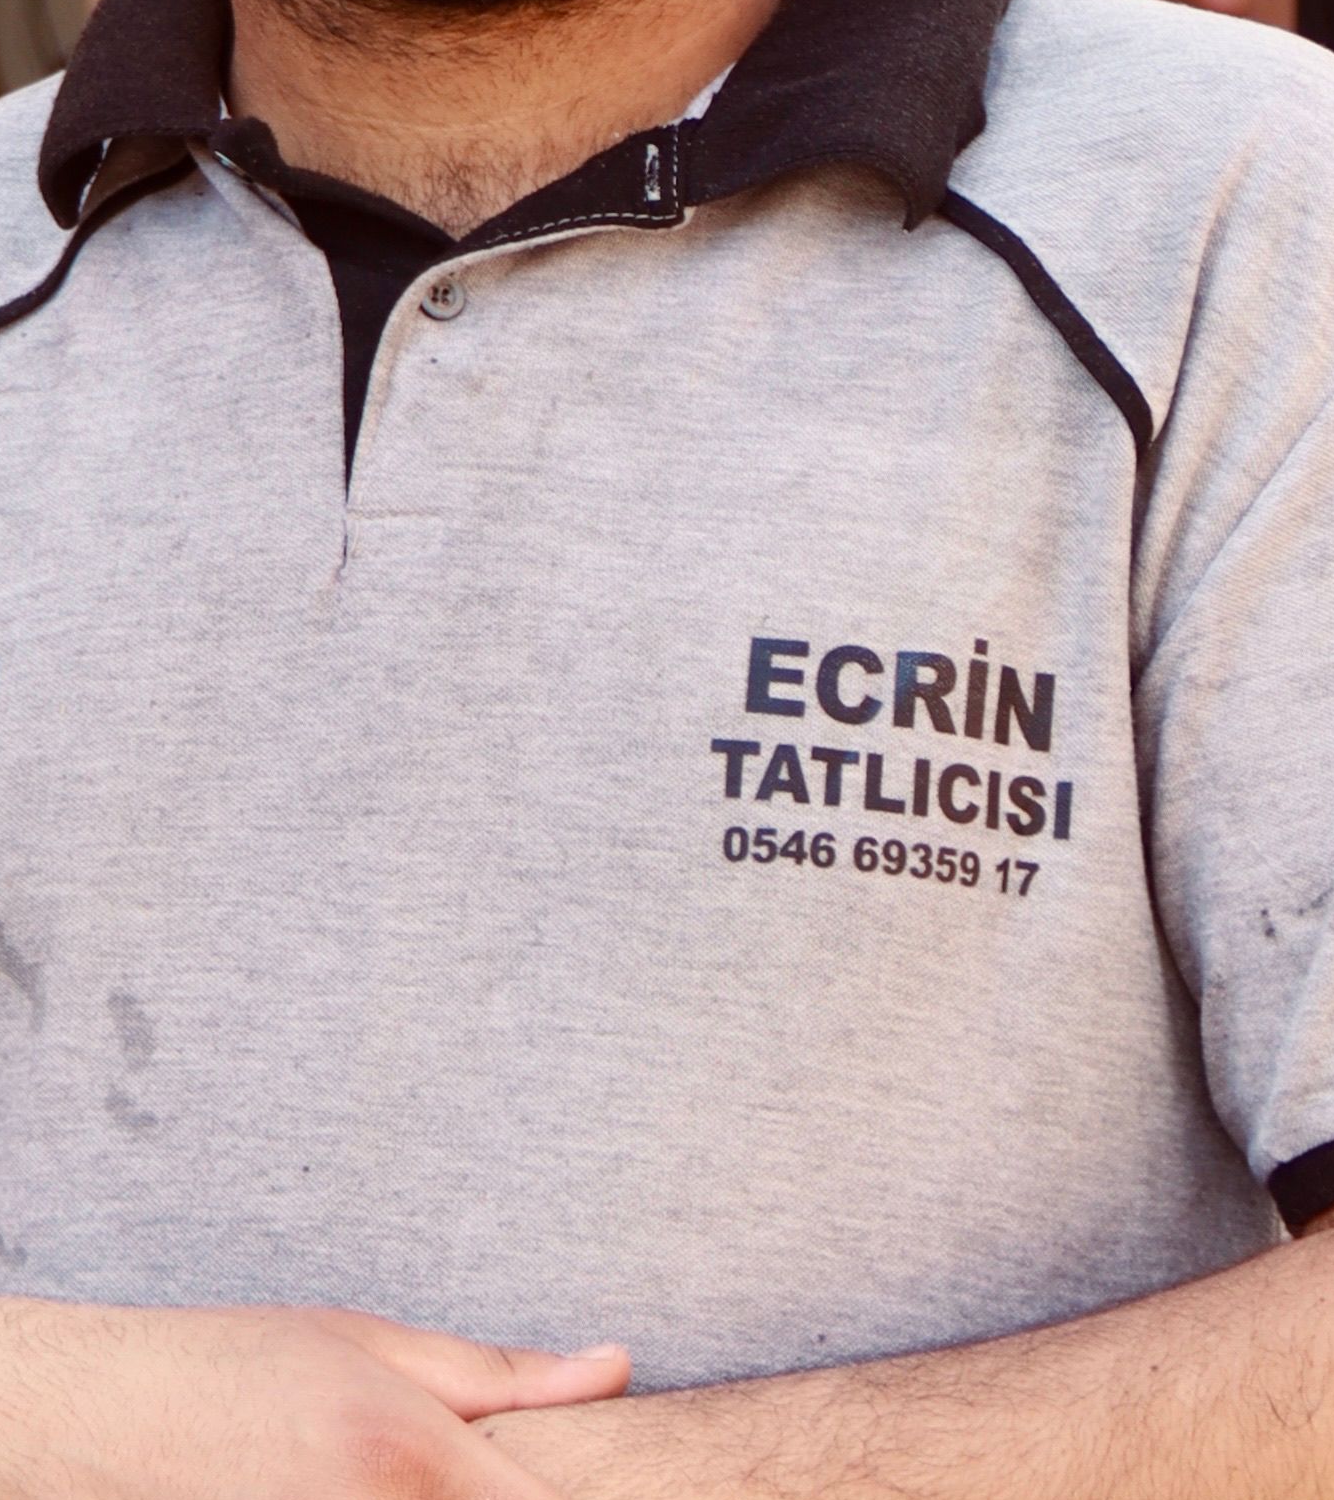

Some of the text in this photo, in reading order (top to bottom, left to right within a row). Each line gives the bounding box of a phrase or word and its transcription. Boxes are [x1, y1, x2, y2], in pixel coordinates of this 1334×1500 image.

[746, 637, 1056, 753] ECRİN
[711, 738, 1073, 841] TATLICISI
[723, 826, 1041, 898] 0546 69359 17
